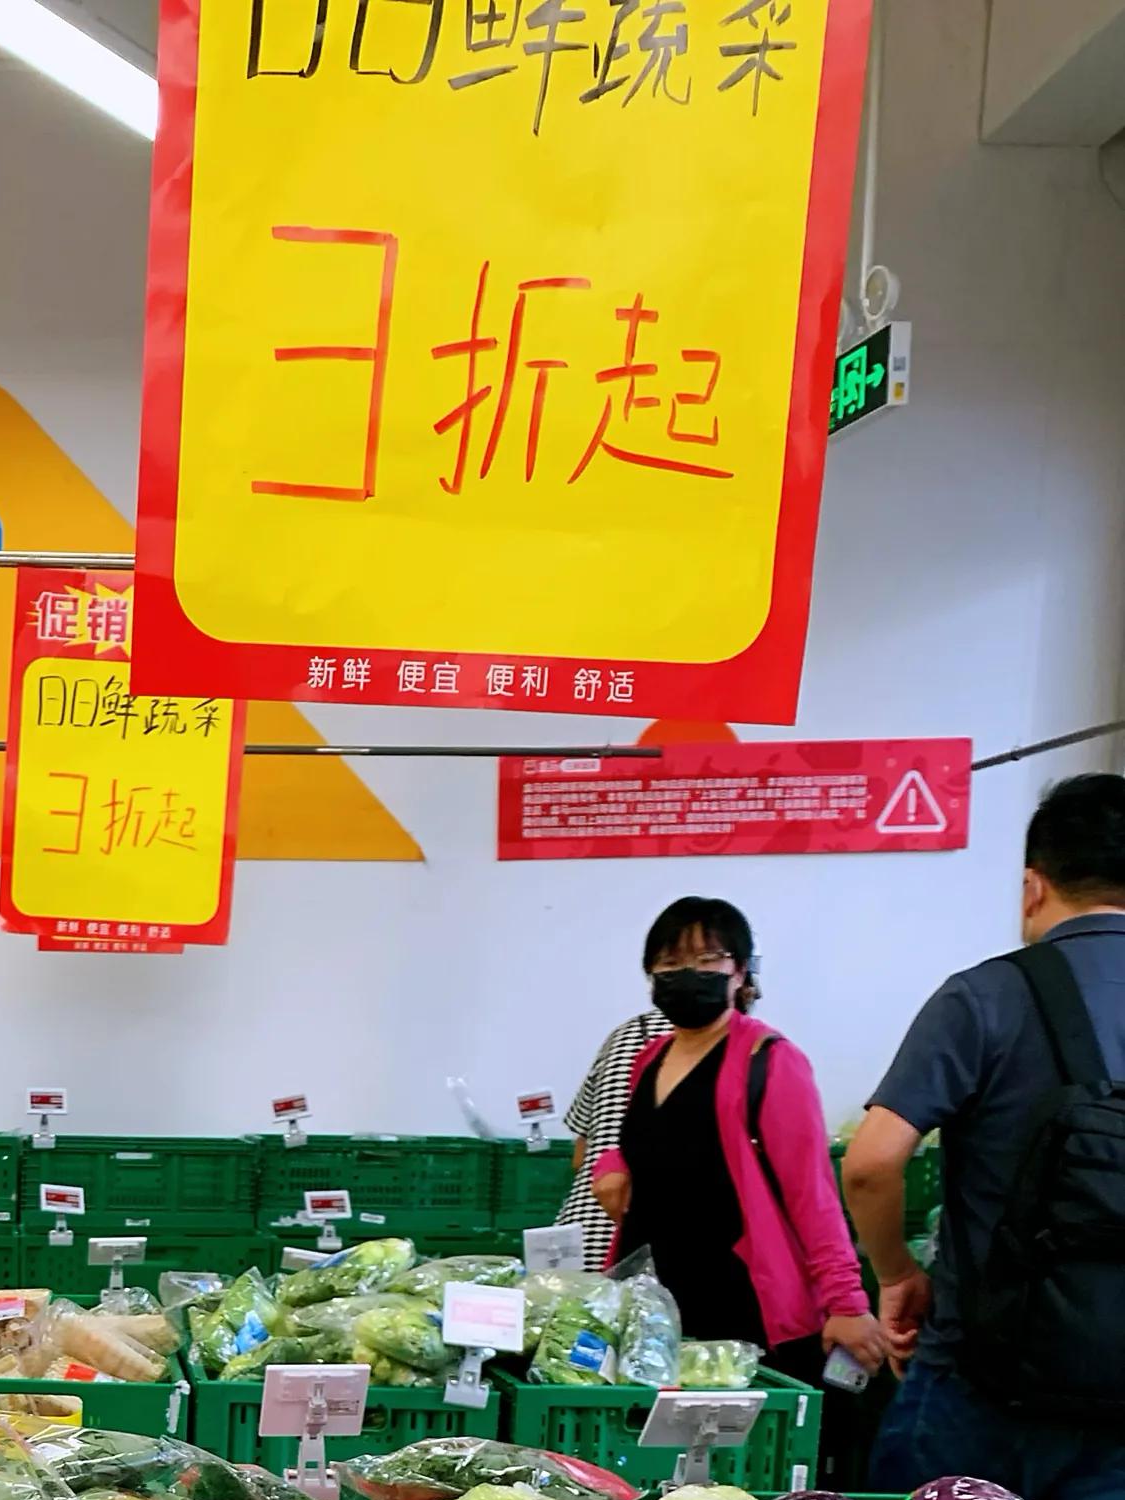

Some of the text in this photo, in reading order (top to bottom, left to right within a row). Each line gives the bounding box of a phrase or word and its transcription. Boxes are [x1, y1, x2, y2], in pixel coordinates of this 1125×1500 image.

[251, 225, 734, 501] 3折起
[307, 655, 637, 705] 新鲜 便宜 便利 舒适
[42, 771, 198, 856] 3折起
